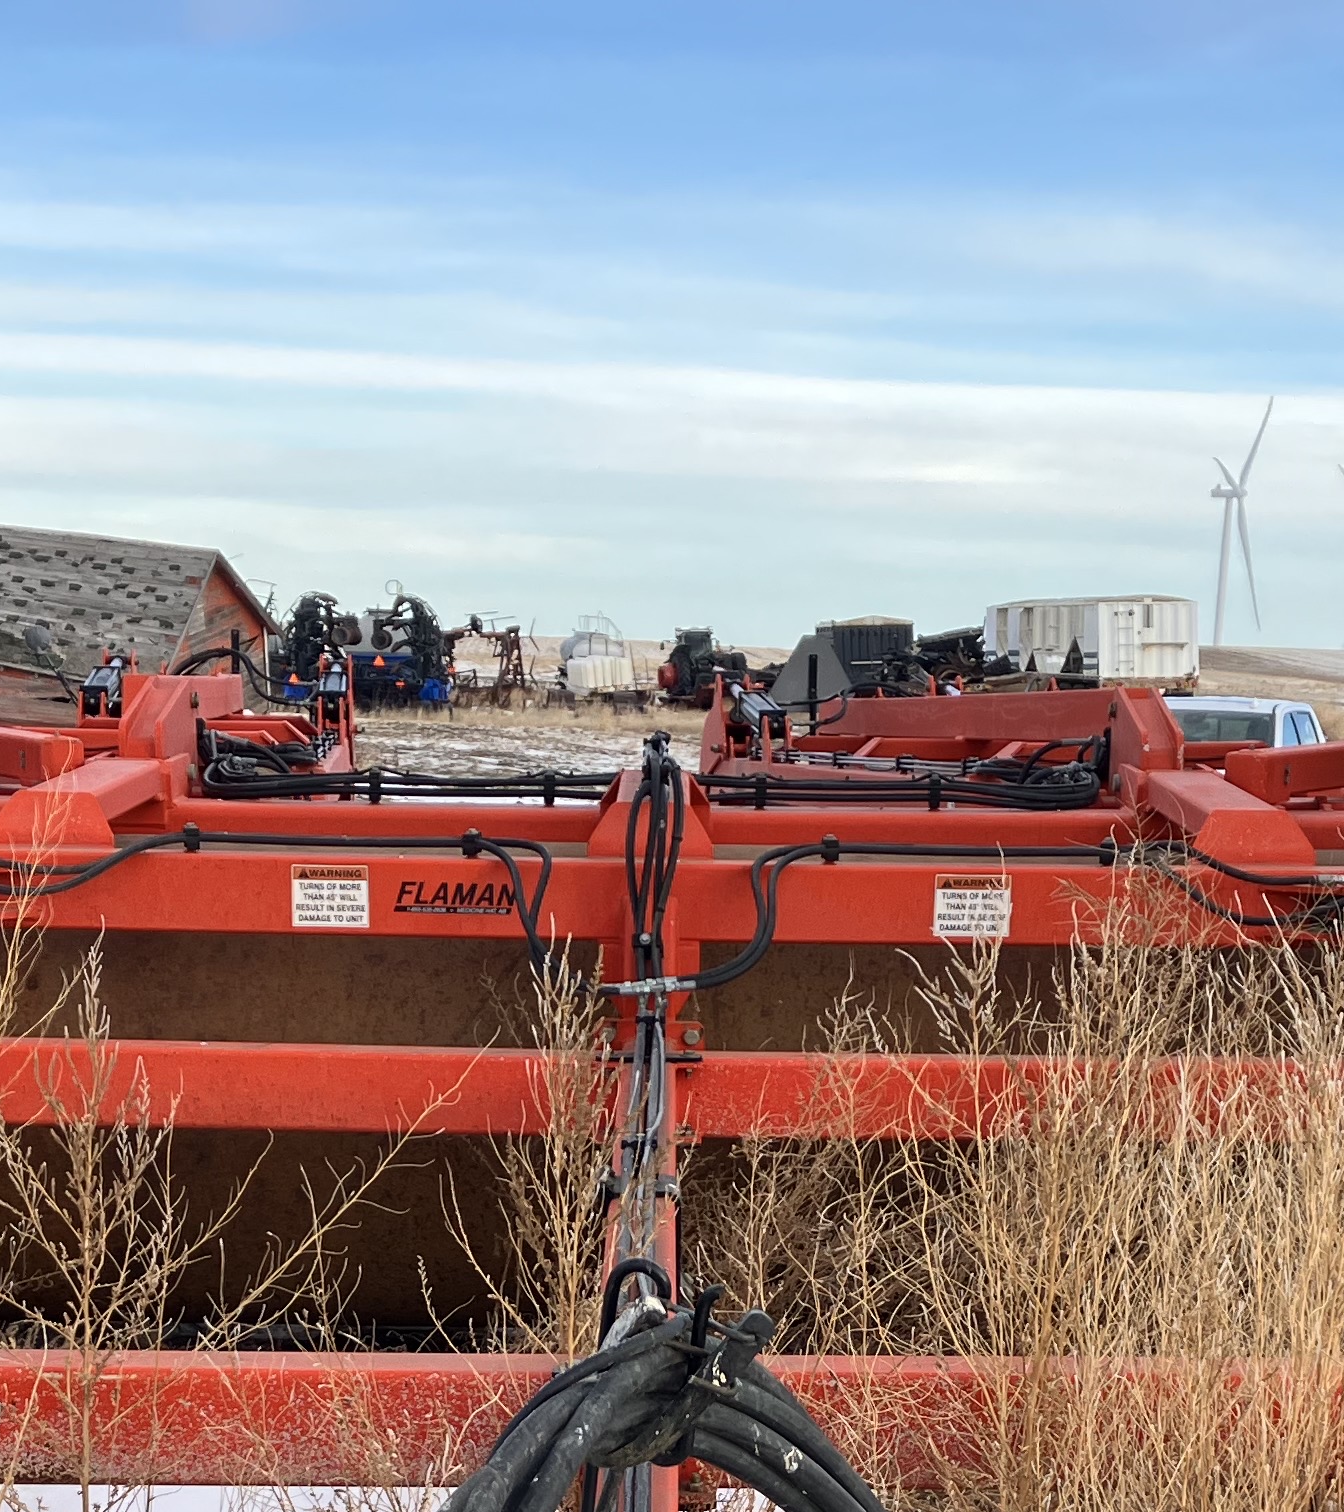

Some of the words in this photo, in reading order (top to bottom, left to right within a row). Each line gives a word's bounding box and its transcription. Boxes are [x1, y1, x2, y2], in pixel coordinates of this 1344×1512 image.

[309, 869, 362, 878] WARNING
[298, 882, 325, 891] TURNS
[326, 883, 337, 891] OF
[339, 883, 362, 891] MORE
[303, 893, 325, 901] THAN
[339, 894, 359, 902] WILL
[396, 881, 516, 906] FLAMAN
[941, 892, 968, 900] TURNS
[969, 892, 980, 900] OF
[295, 904, 325, 912] RESULT
[326, 904, 335, 912] IN
[336, 904, 366, 912] SEVERE
[946, 902, 967, 911] THAN
[298, 914, 332, 923] DAMAGE
[333, 914, 344, 923] TO
[345, 915, 364, 923] UNIT
[937, 913, 966, 921] RESULT
[939, 923, 972, 932] DAMAGE
